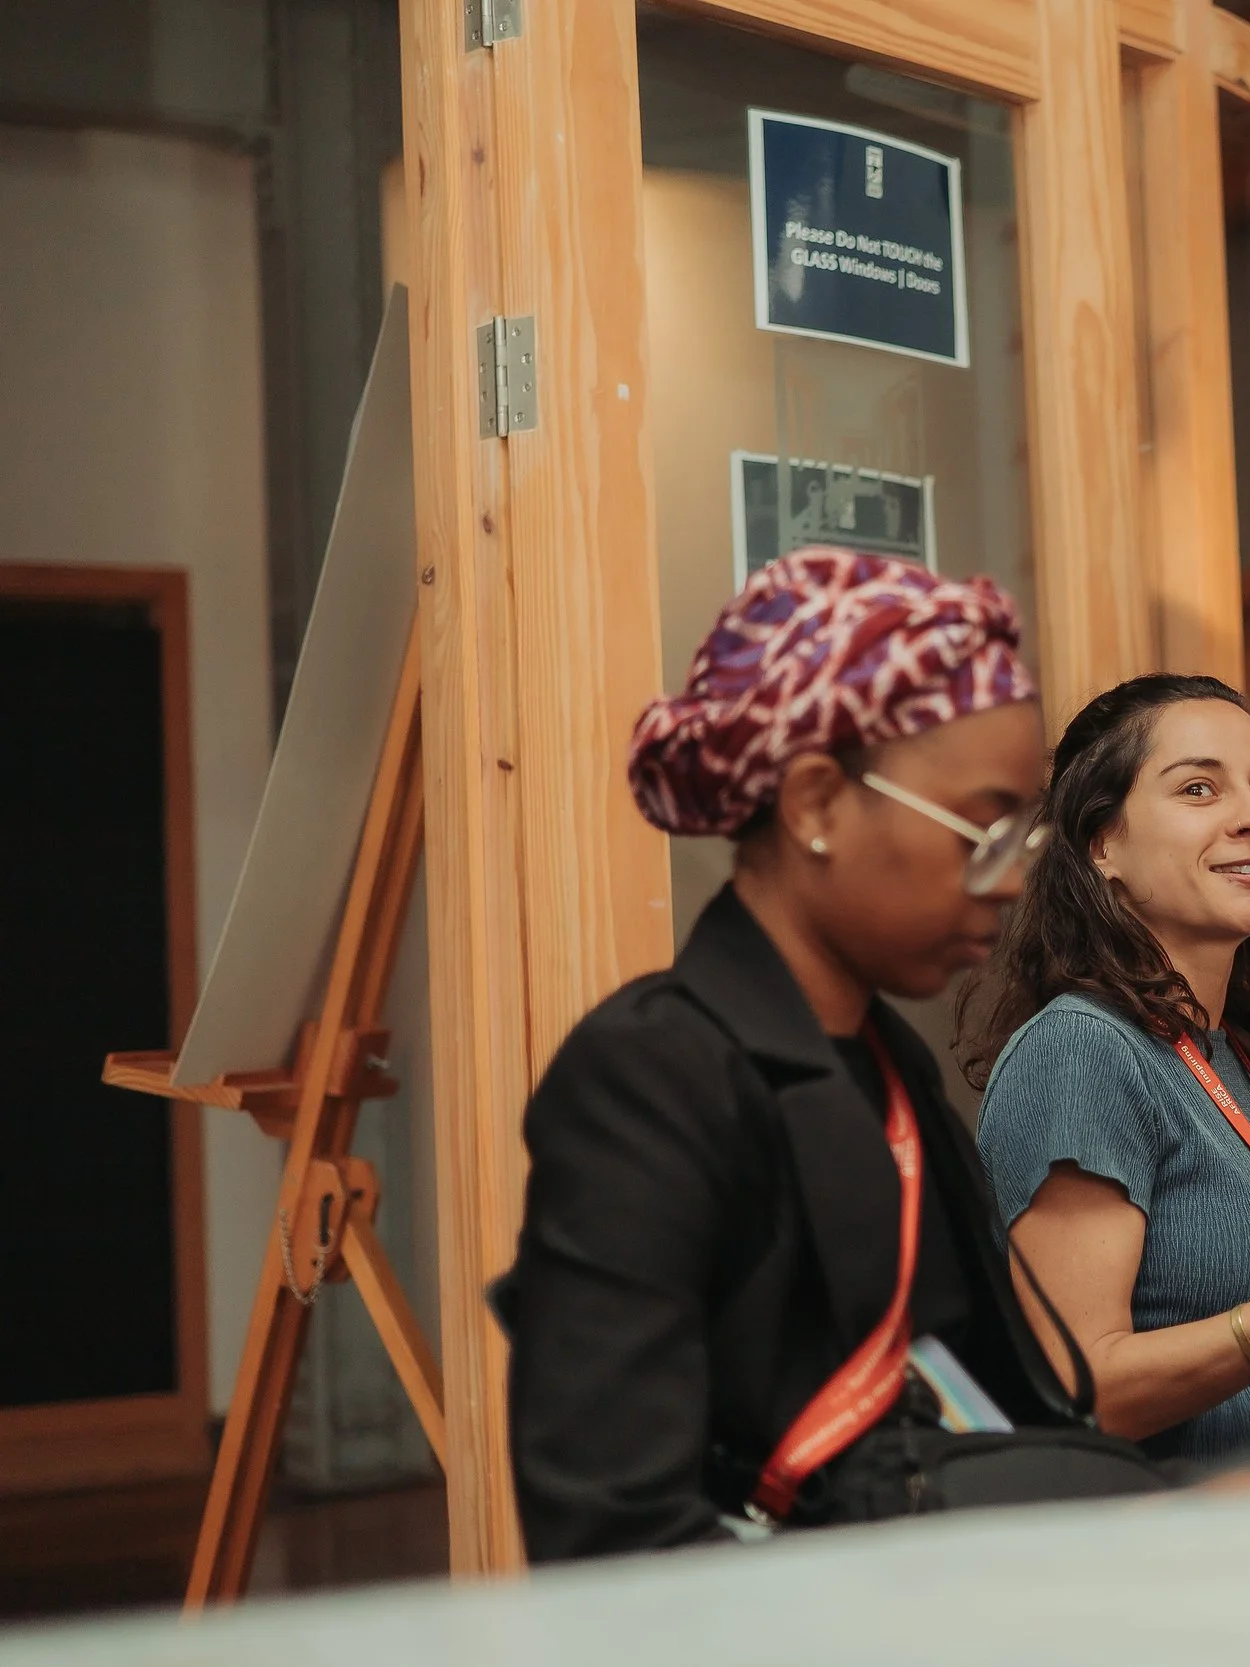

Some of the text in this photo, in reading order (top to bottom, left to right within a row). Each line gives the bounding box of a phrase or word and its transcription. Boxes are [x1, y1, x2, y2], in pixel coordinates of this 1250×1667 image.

[786, 221, 943, 272] Please Do Not TOUCH the
[791, 248, 838, 271] GLASS
[838, 255, 897, 284] Windows
[906, 271, 941, 295] Doors
[1181, 1045, 1211, 1084] Inspiring
[1211, 1087, 1228, 1108] RISE
[1216, 1084, 1240, 1115] AFRICA
